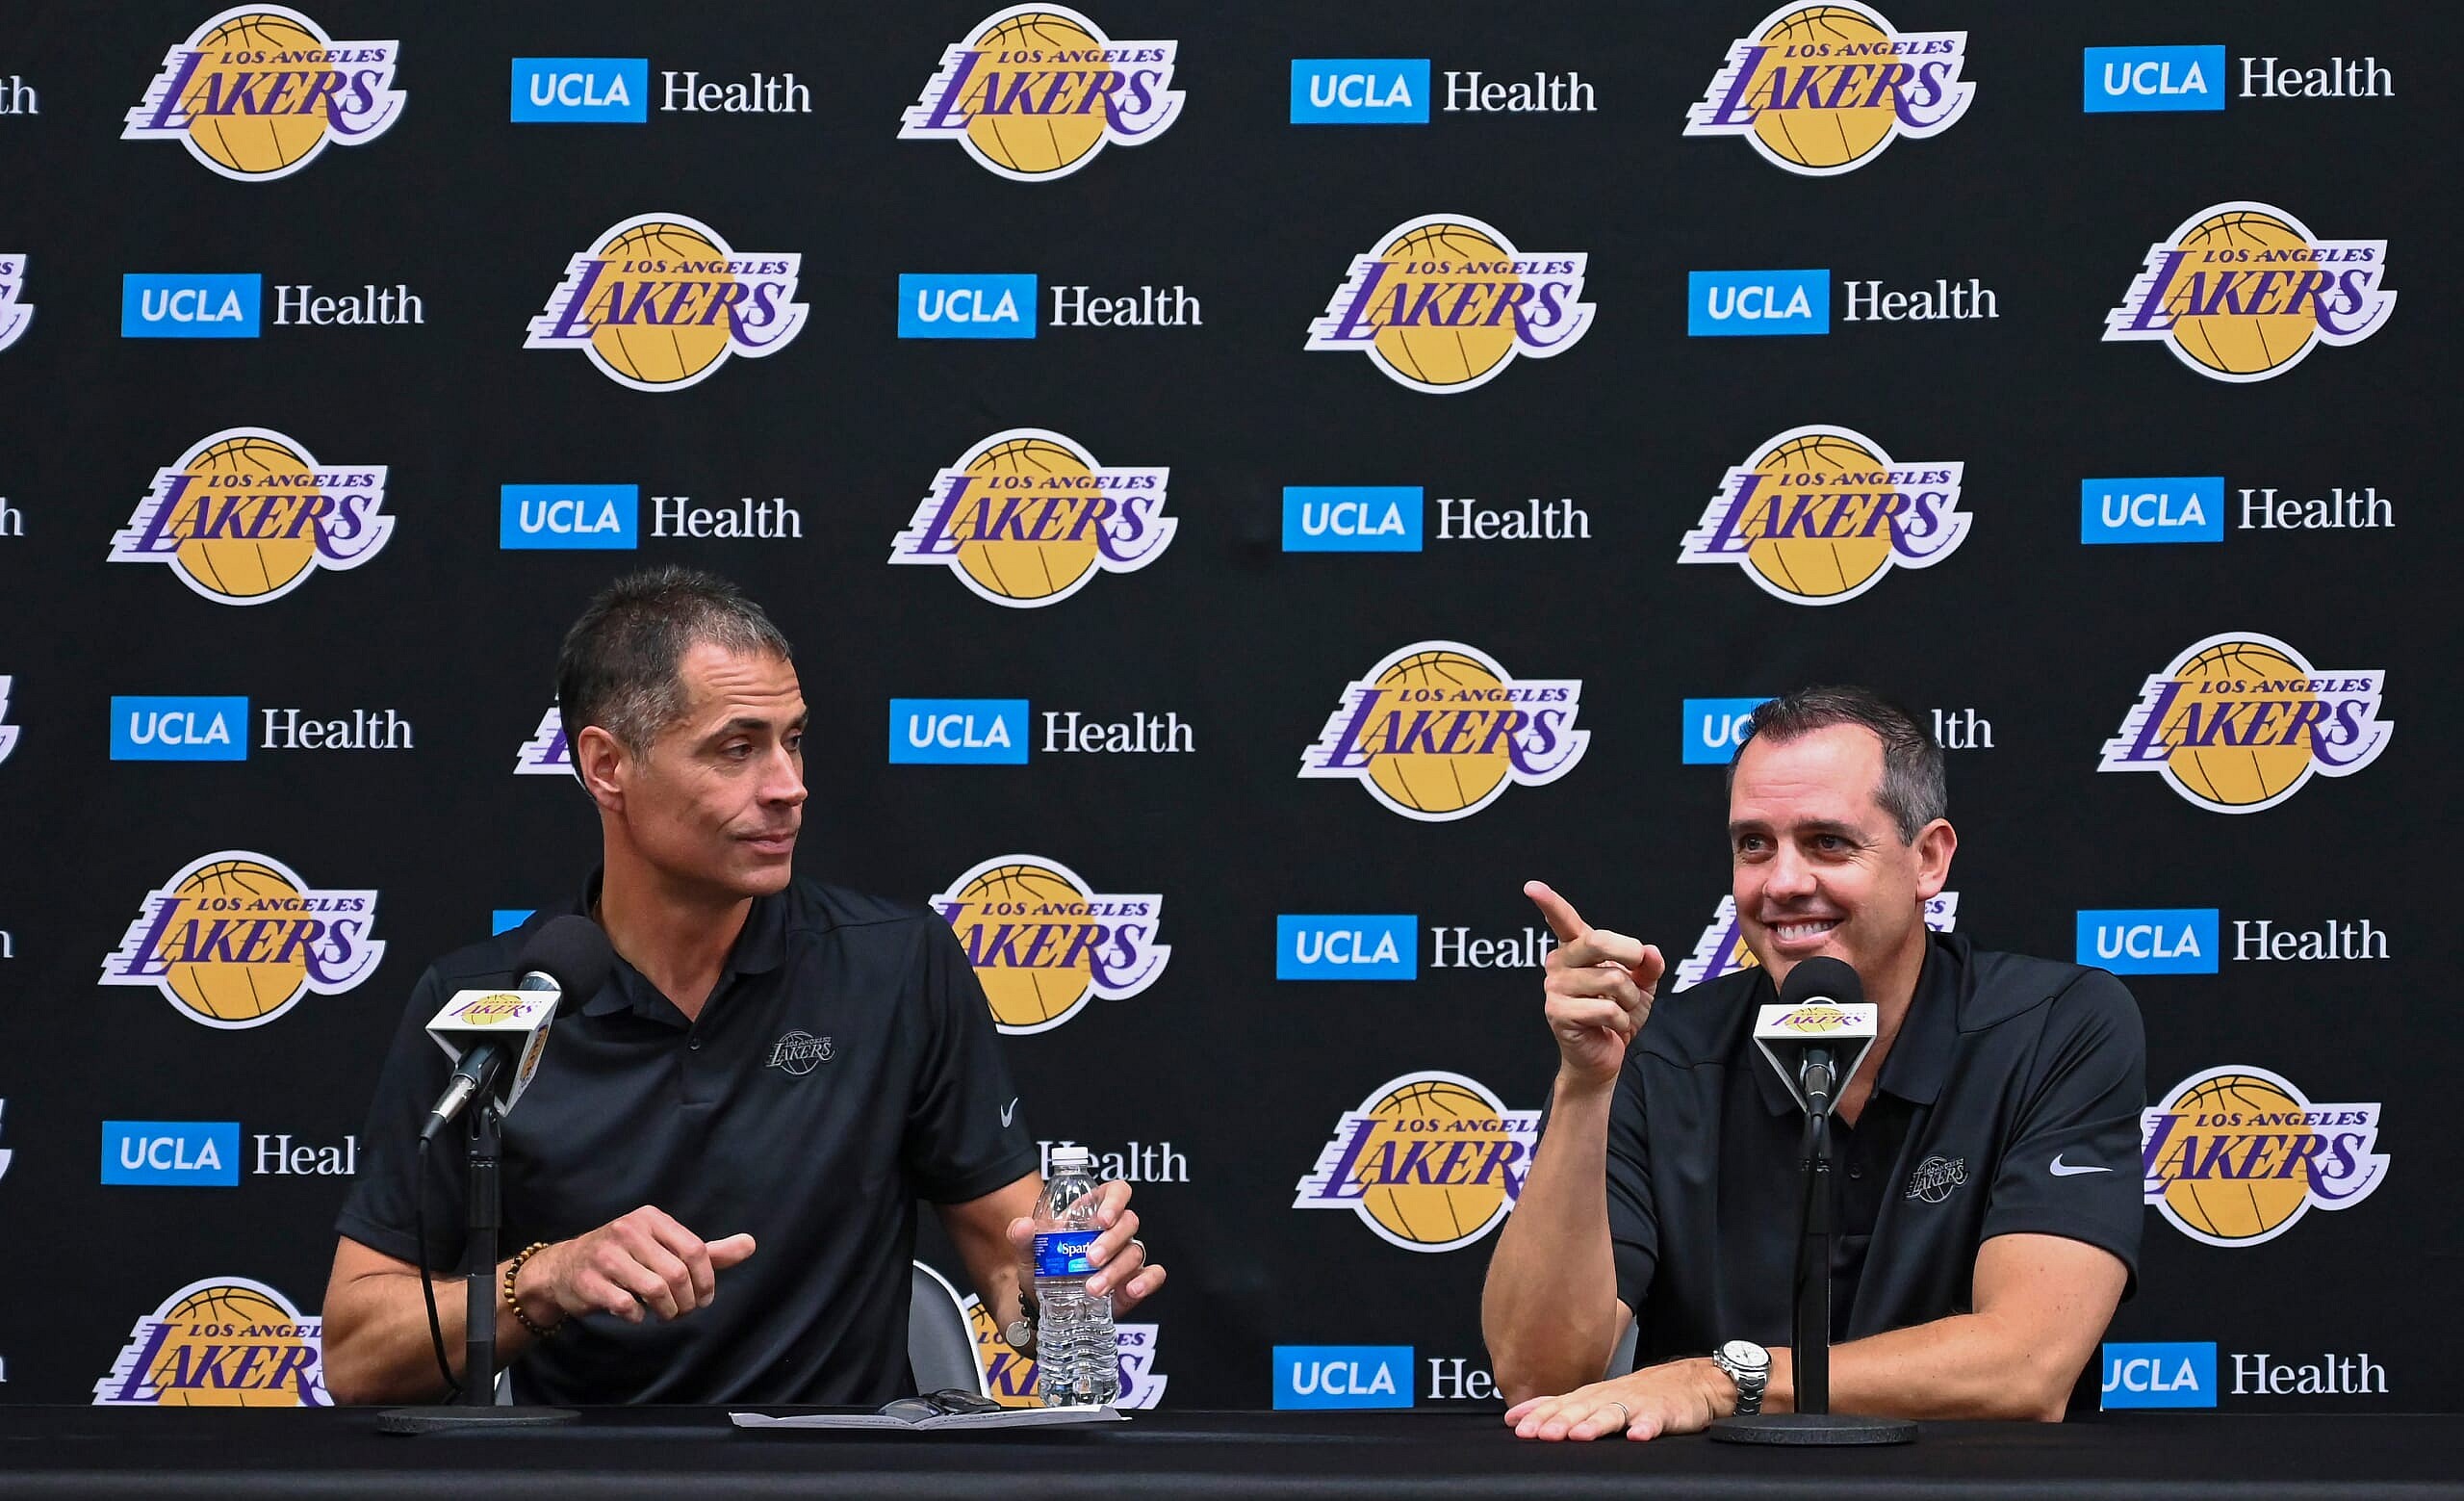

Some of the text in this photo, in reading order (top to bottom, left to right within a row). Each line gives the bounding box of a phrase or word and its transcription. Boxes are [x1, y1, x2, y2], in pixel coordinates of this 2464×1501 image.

[220, 49, 387, 64] LOS ANGELES
[997, 49, 1165, 63] LOS ANGELES
[1784, 40, 1955, 58] LOS ANGELES
[137, 52, 394, 134] LAKERS
[531, 71, 811, 113] UCLA Health
[913, 51, 1172, 135] LAKERS
[1311, 72, 1597, 112] UCLA Health
[1700, 45, 1963, 127] LAKERS
[2105, 58, 2395, 98] UCLA Health
[623, 261, 788, 274] LOS ANGELES
[1405, 261, 1575, 274] LOS ANGELES
[2203, 247, 2374, 263] LOS ANGELES
[142, 285, 424, 324] UCLA Health
[539, 260, 796, 347] LAKERS
[918, 286, 1202, 325] UCLA Health
[1321, 262, 1582, 348] LAKERS
[1709, 279, 1999, 321] UCLA Health
[2118, 250, 2383, 335] LAKERS
[208, 474, 374, 487] LOS ANGELES
[988, 476, 1157, 489] LOS ANGELES
[1780, 471, 1951, 486] LOS ANGELES
[123, 475, 381, 559] LAKERS
[521, 497, 802, 537] UCLA Health
[904, 477, 1164, 561] LAKERS
[1303, 499, 1591, 539] UCLA Health
[1694, 474, 1959, 557] LAKERS
[2103, 488, 2395, 529] UCLA Health
[1399, 688, 1569, 701] LOS ANGELES
[2199, 678, 2372, 693] LOS ANGELES
[131, 710, 413, 749] UCLA Health
[910, 712, 1194, 752] UCLA Health
[1314, 689, 1577, 775] LAKERS
[2114, 682, 2380, 765] LAKERS
[196, 898, 365, 911] LOS ANGELES
[981, 902, 1149, 916] LOS ANGELES
[113, 898, 372, 984] LAKERS
[1297, 927, 1555, 969] UCLA Healt
[2098, 919, 2390, 960] UCLA Health
[766, 1043, 835, 1067] LAKERS
[1394, 1119, 1539, 1132] LOS ANGEL
[2195, 1111, 2368, 1126] LOS ANGELES
[121, 1135, 355, 1175] UCLA Heal
[1309, 1120, 1537, 1202] LAKER
[2143, 1114, 2376, 1200] LAKERS
[189, 1324, 321, 1338] LOS ANGEL
[105, 1324, 325, 1407] LAKER
[1294, 1362, 1395, 1394] UCLA
[2230, 1354, 2389, 1394] Health
